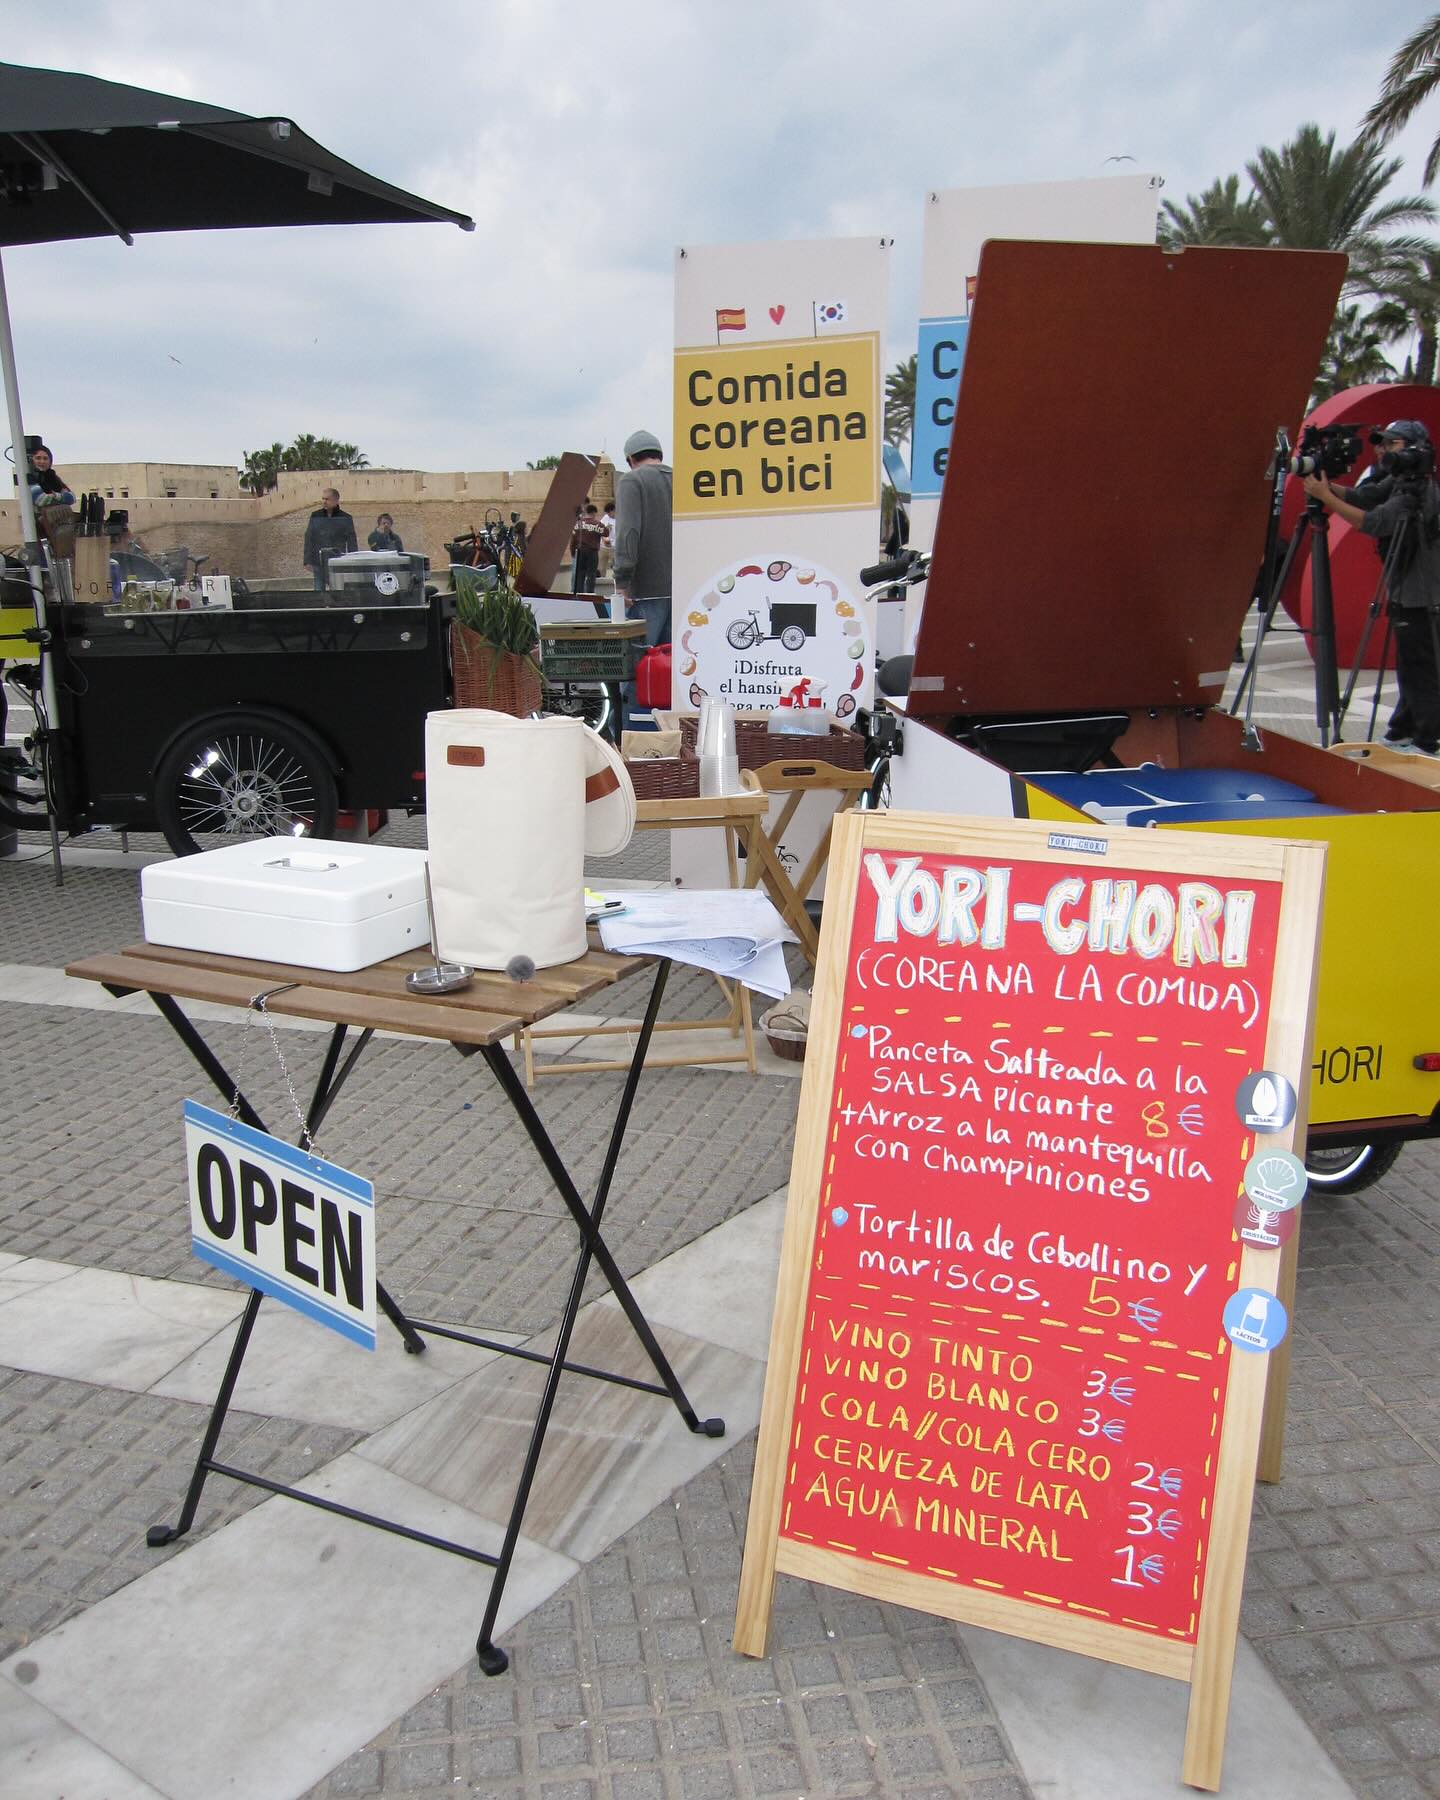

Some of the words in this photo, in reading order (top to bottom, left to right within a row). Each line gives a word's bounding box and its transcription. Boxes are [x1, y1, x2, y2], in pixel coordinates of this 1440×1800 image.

[688, 361, 848, 407] Comida
[932, 341, 959, 380] C
[689, 411, 866, 451] coreana
[692, 468, 743, 498] en
[761, 453, 832, 494] bici
[719, 679, 732, 694] el
[734, 659, 803, 677] ¡Disfruta
[863, 852, 1256, 968] YORI-CHORI
[855, 949, 1034, 995] (COREANA
[1054, 964, 1103, 1002] LA
[1116, 972, 1261, 1029] COMIDA)
[868, 1025, 973, 1066] Panceta
[983, 1039, 1125, 1086] Salteada
[1136, 1069, 1157, 1091] a
[1175, 1065, 1208, 1095] la
[872, 1068, 982, 1102] SALSA
[993, 1082, 1114, 1125] picante
[957, 1116, 975, 1136] a
[986, 1119, 1011, 1144] la
[1025, 1129, 1212, 1182] mantequilla
[197, 1142, 364, 1311] OPEN
[853, 1203, 972, 1252] Tortilla
[983, 1226, 1015, 1260] de
[1027, 1231, 1171, 1285] Cebollino
[828, 1319, 912, 1359] VINO
[929, 1337, 1033, 1383] TINTO
[823, 1354, 908, 1389] VINO
[927, 1373, 1059, 1425] BLANCO
[813, 1434, 959, 1488] CERVEZA
[971, 1467, 1002, 1498] DE
[1016, 1475, 1089, 1520] LATA
[1028, 1439, 1112, 1482] CERO
[805, 1471, 904, 1528] AGUA
[915, 1495, 1074, 1563] MINERAL
